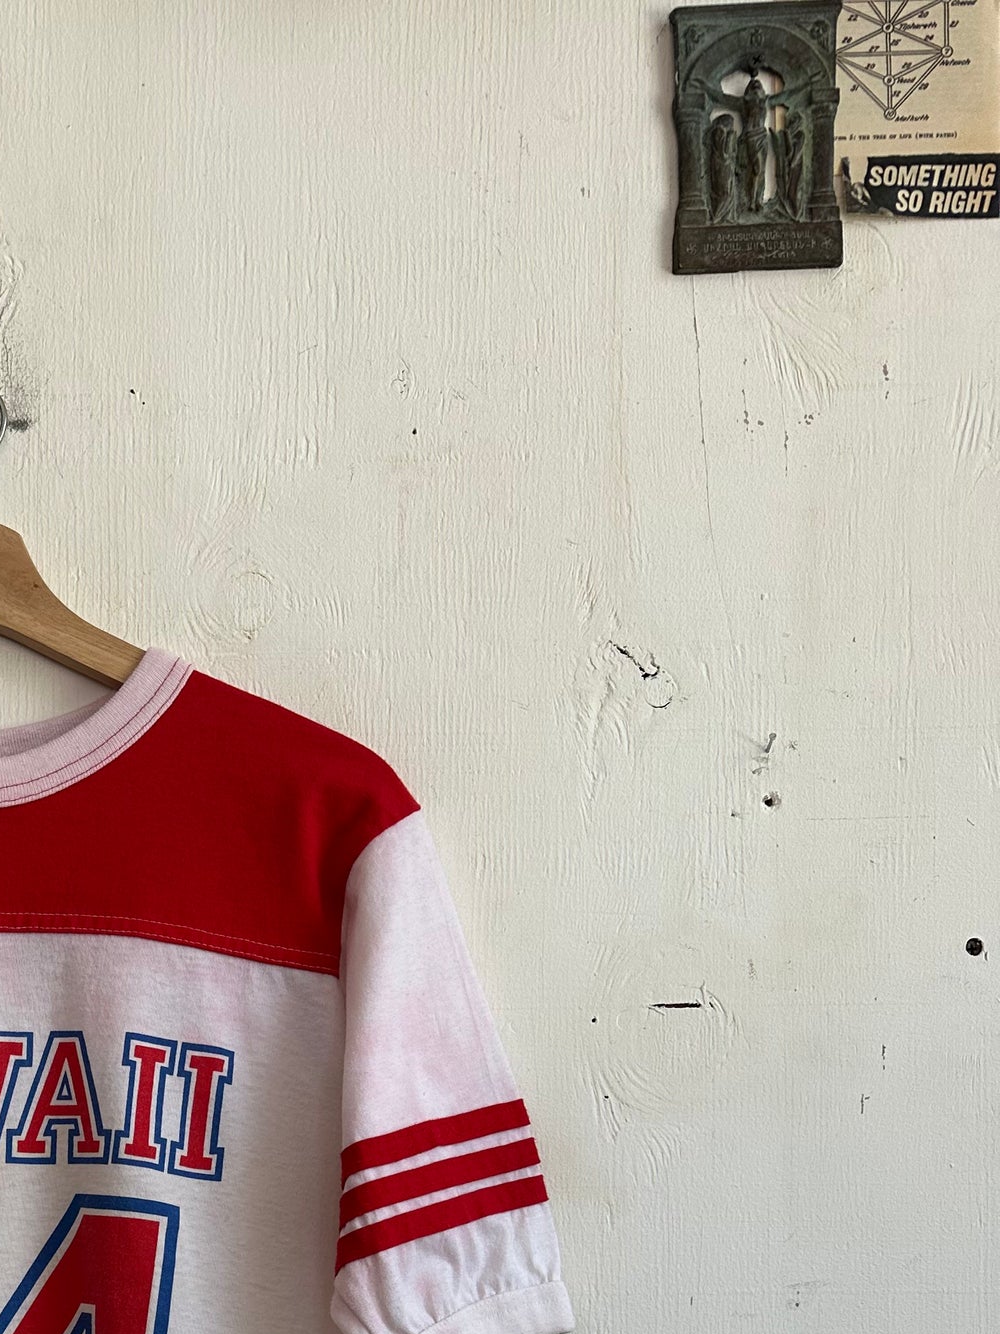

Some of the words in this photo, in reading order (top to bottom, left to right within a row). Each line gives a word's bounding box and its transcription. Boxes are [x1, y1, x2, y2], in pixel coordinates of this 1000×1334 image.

[869, 163, 997, 188] SOMETHING
[895, 189, 924, 213] SO
[929, 190, 996, 214] RIGHT
